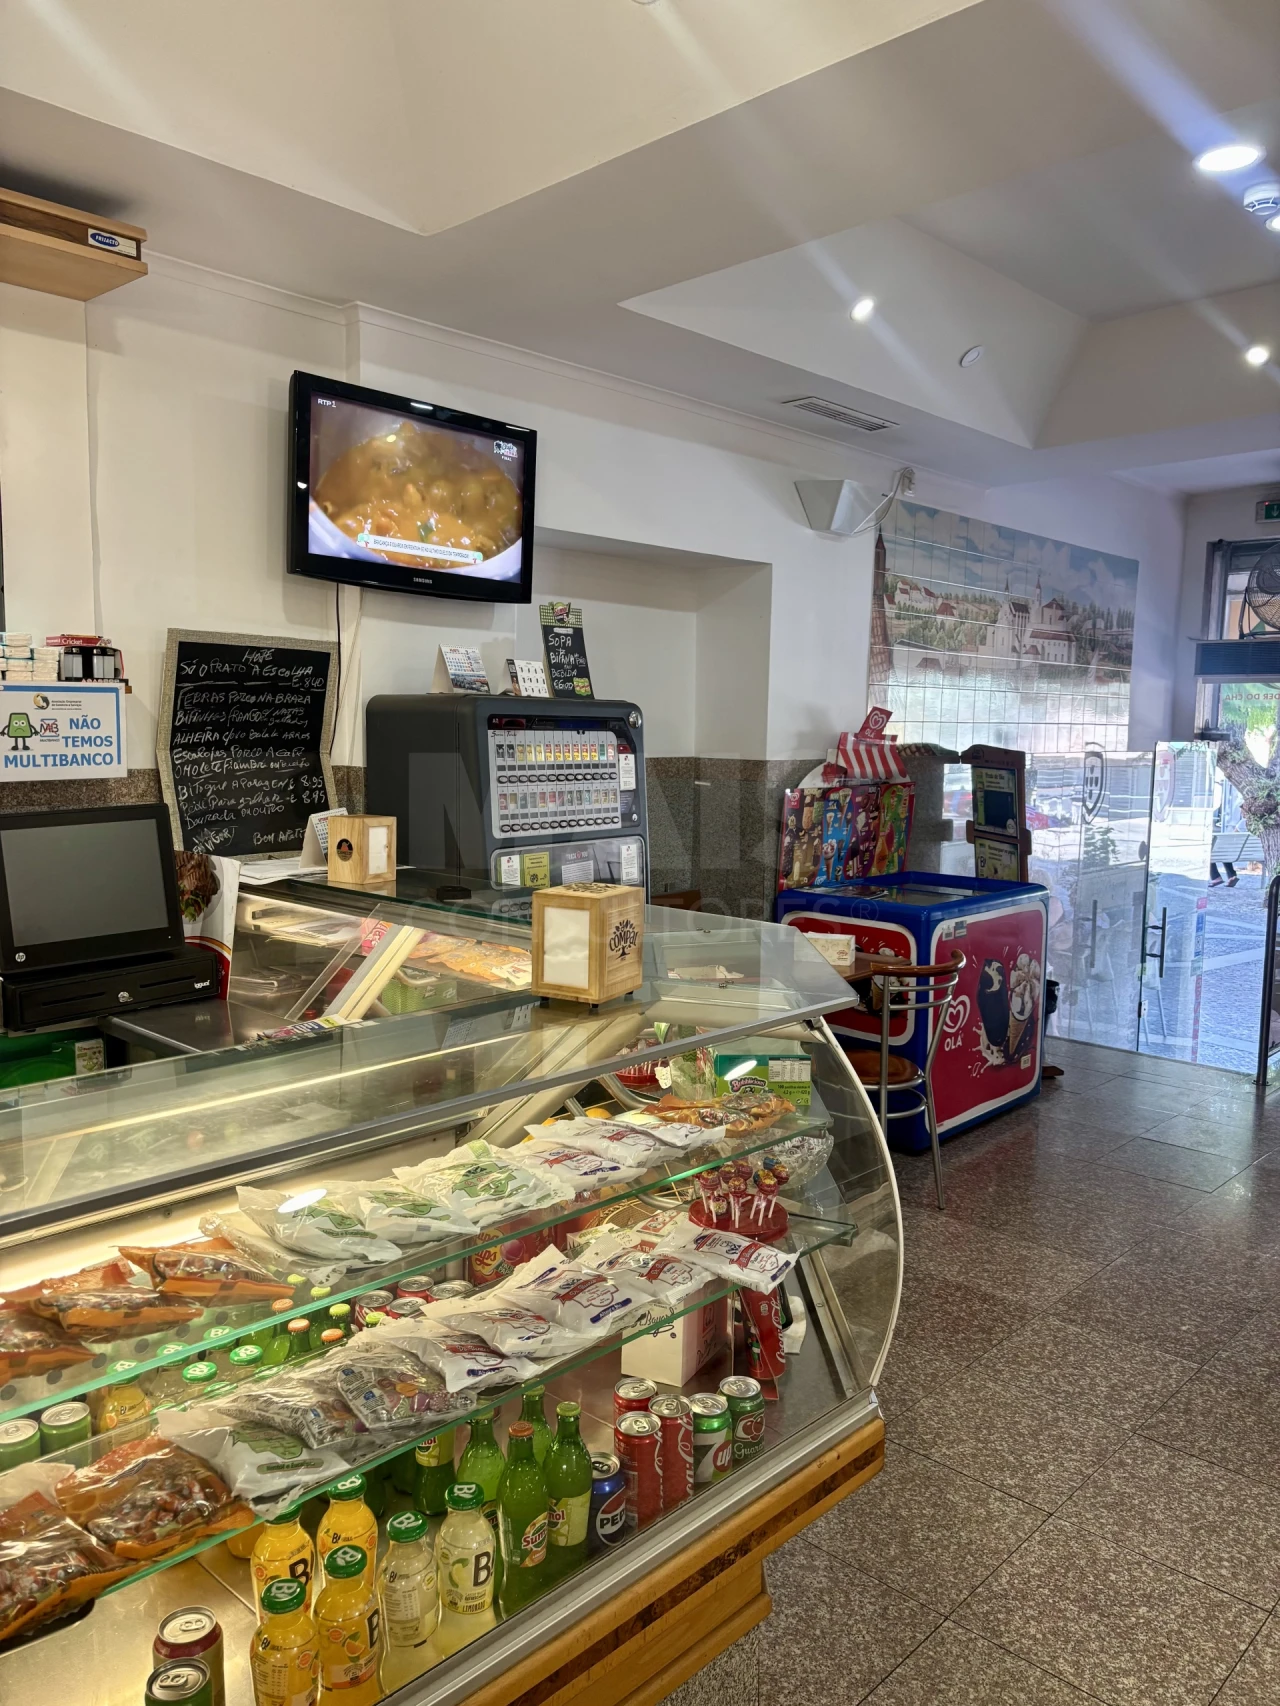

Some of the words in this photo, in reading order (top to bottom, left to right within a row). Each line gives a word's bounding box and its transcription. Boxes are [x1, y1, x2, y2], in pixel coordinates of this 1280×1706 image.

[69, 714, 101, 730] NÃO
[62, 735, 113, 748] TEMOS
[4, 752, 114, 768] MULTIBANCO
[944, 1031, 965, 1052] OLÁ
[600, 1514, 625, 1529] PEP
[522, 1530, 547, 1549] Sum
[472, 1551, 494, 1587] B!
